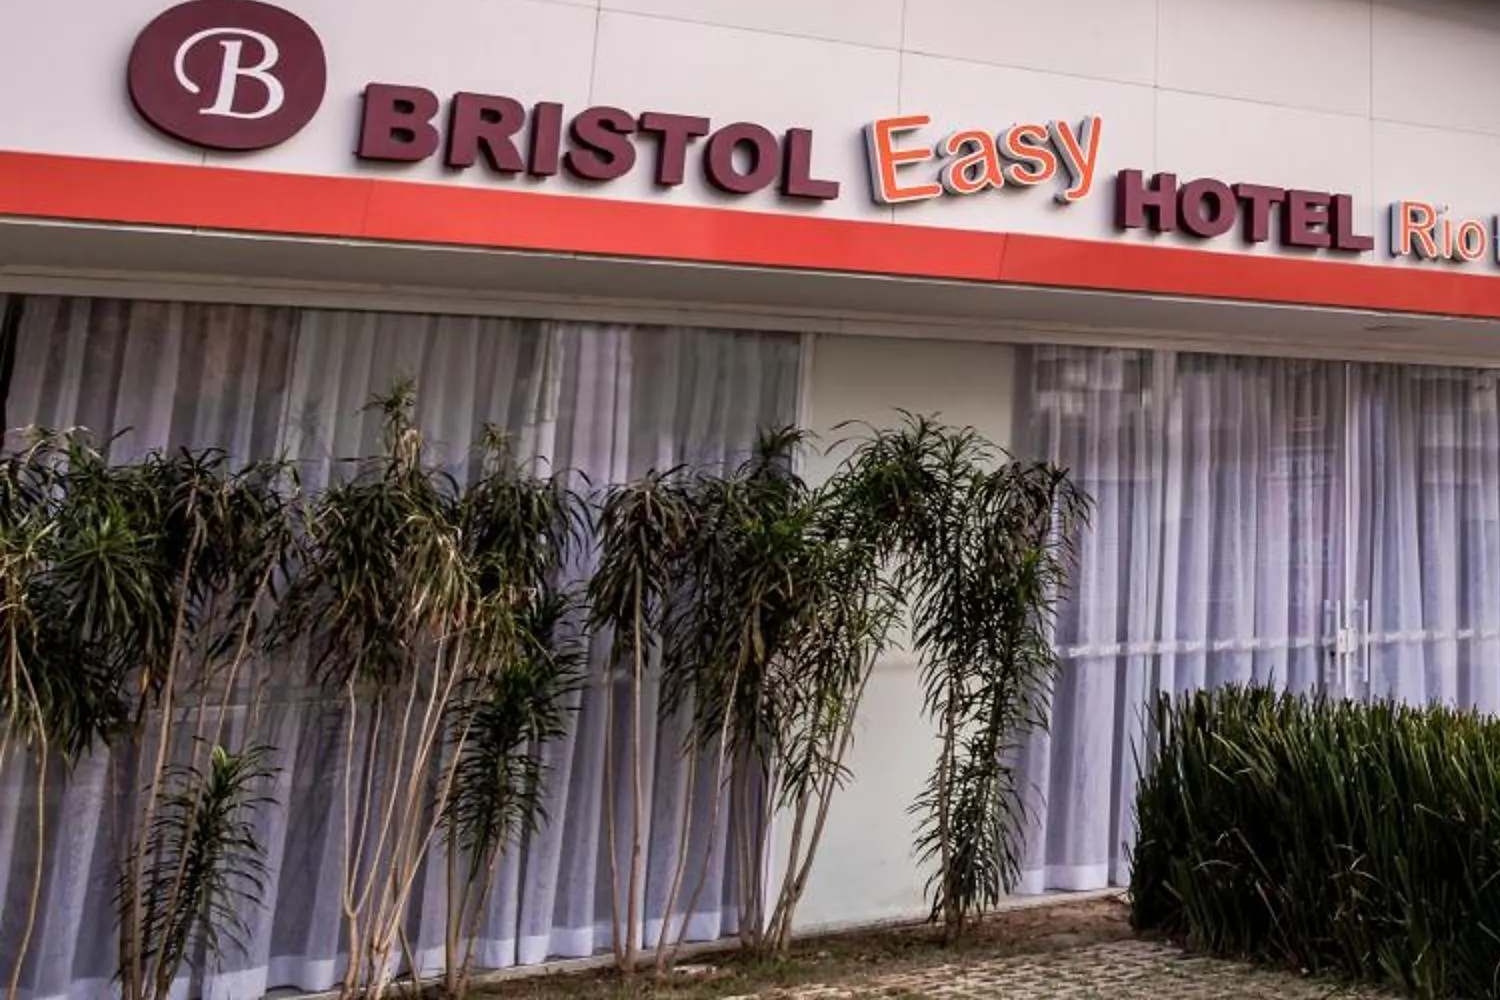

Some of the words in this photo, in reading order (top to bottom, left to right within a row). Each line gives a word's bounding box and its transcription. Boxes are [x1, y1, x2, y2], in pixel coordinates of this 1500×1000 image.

[354, 82, 841, 200] BRISTOL
[862, 114, 1103, 206] Easy
[1115, 168, 1375, 252] HOTEL
[1390, 199, 1487, 262] Rio
